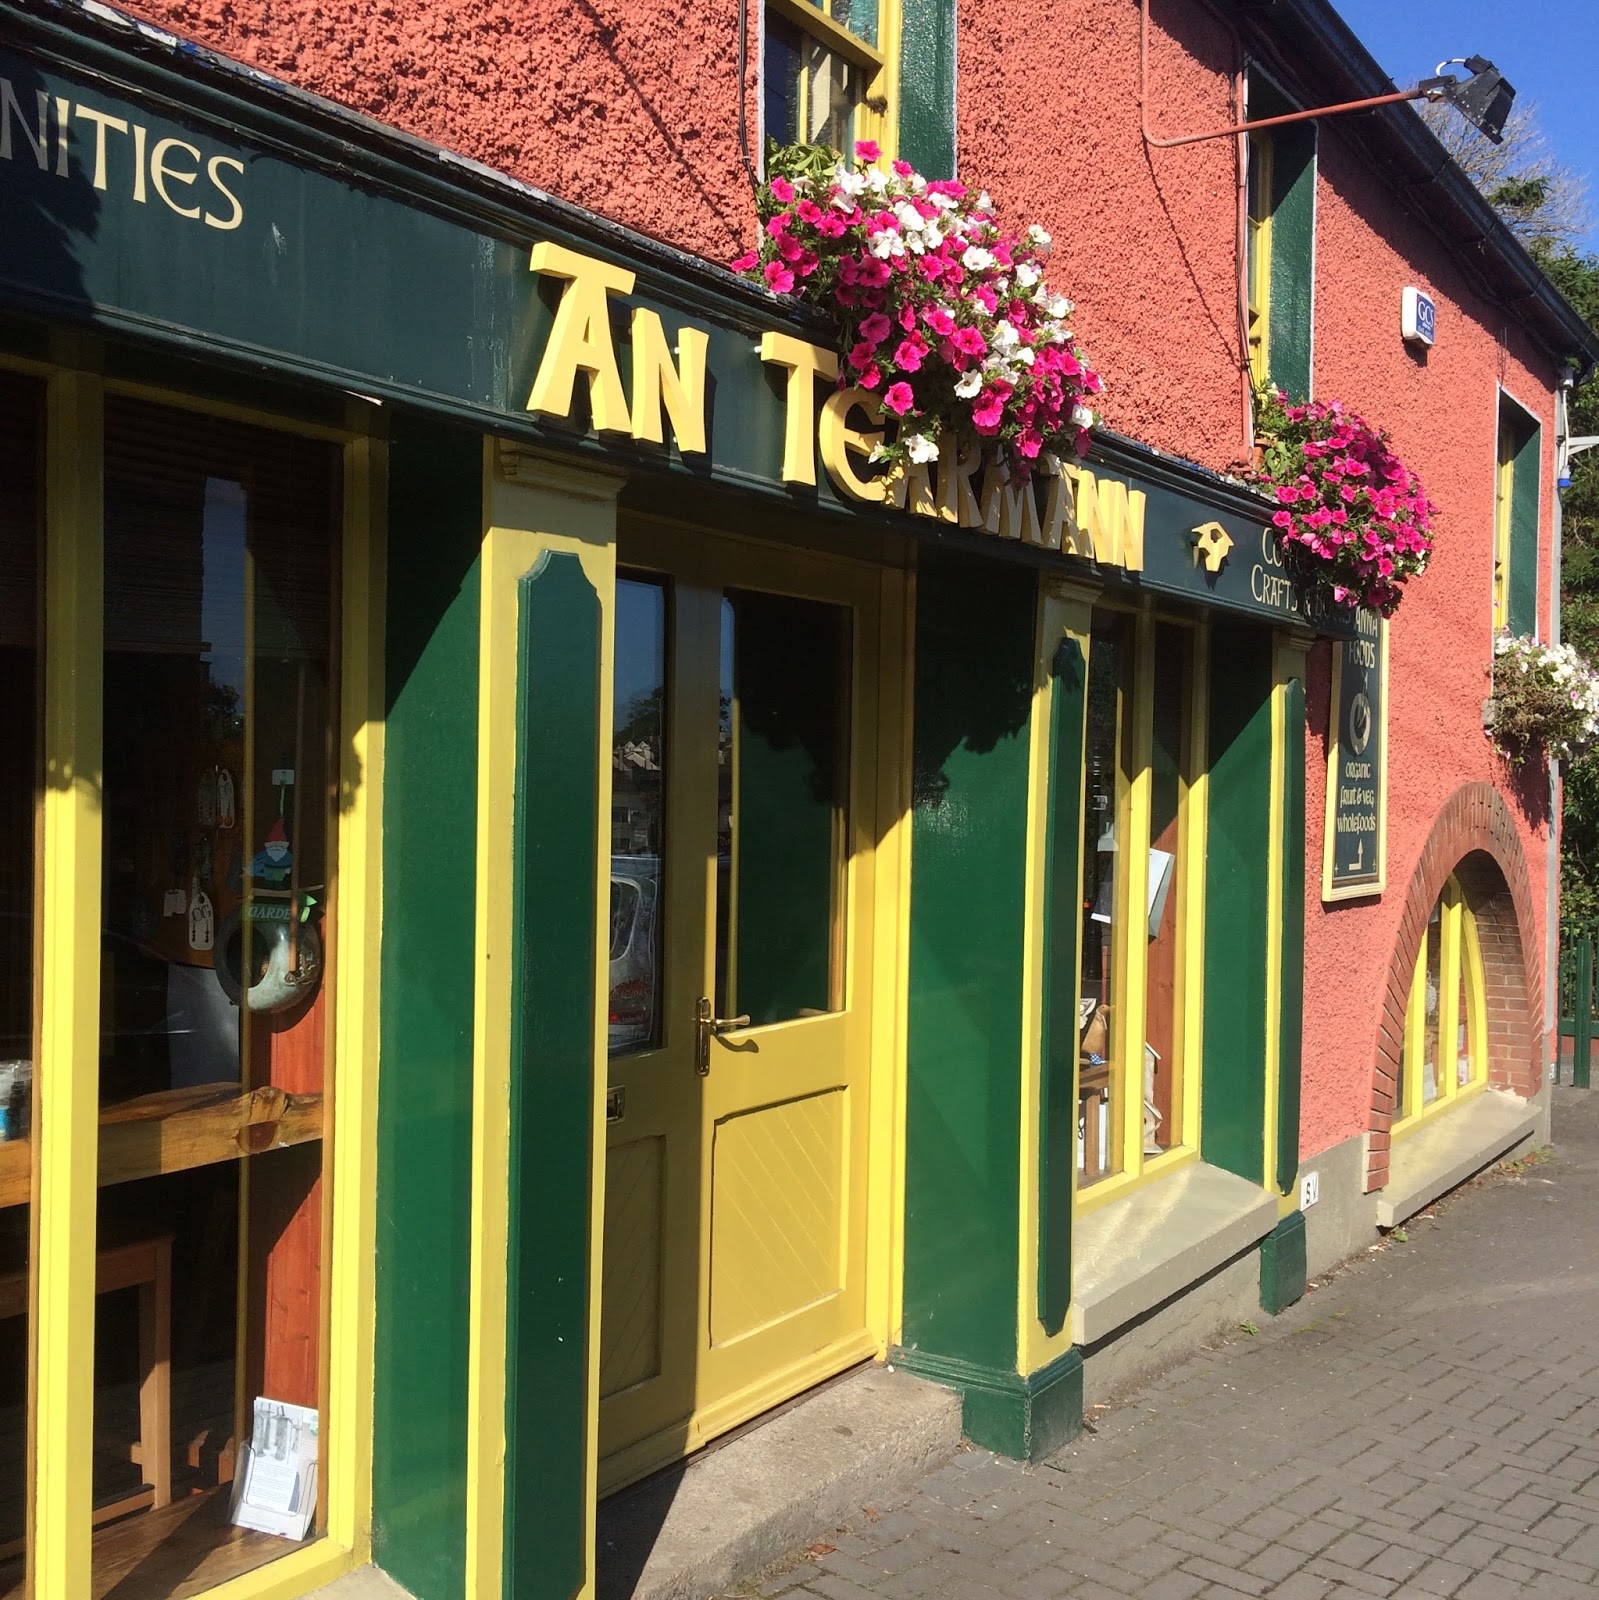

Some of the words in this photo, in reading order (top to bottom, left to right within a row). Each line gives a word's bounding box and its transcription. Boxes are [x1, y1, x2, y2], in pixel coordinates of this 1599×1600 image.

[526, 241, 709, 454] AN
[1251, 564, 1299, 612] CRAFTS
[1337, 812, 1376, 835] wholefoods
[248, 905, 294, 920] GARDE
